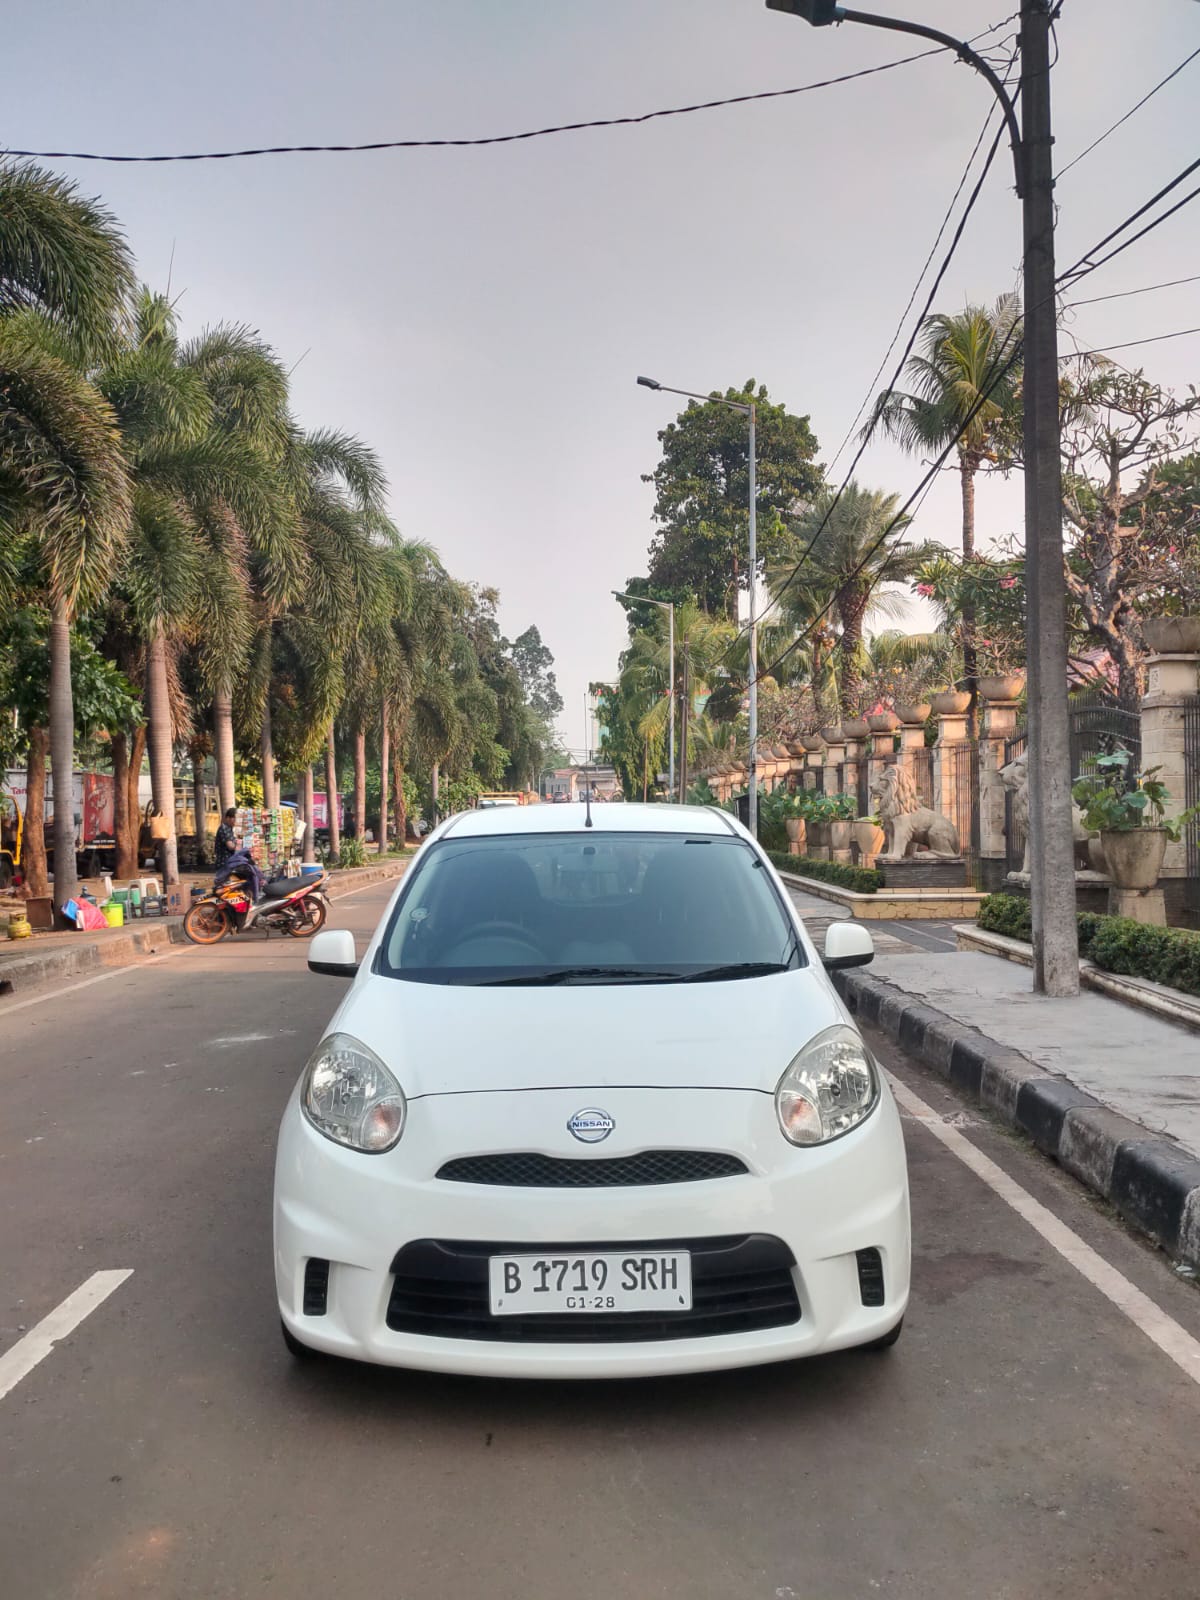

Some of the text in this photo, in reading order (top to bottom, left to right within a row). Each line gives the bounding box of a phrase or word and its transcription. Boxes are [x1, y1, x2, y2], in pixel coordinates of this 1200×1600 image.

[572, 1120, 611, 1128] NISSAN
[504, 1257, 678, 1294] B 1719 SRH
